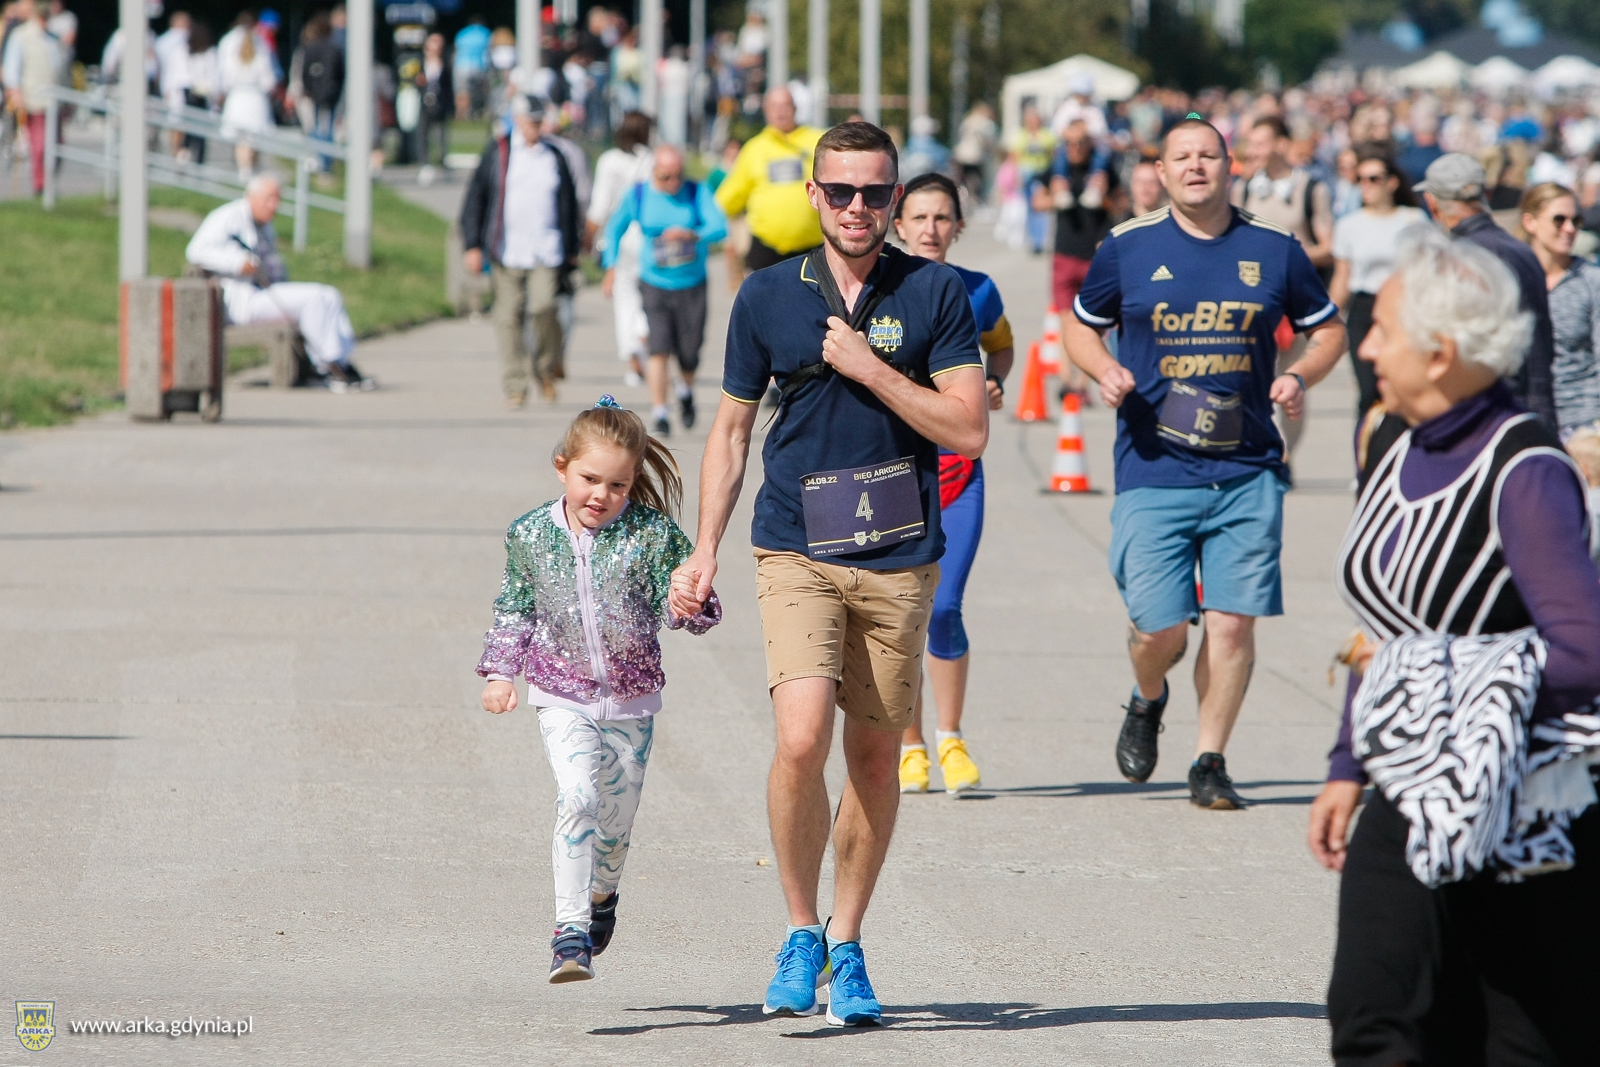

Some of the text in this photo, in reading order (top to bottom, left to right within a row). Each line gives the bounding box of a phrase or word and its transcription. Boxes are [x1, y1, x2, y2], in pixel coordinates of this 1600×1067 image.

[1151, 301, 1264, 332] forBET
[1159, 354, 1251, 379] GDYNIA
[1193, 407, 1217, 434] 16
[853, 461, 911, 481] BIEG ARKOWCA
[855, 491, 874, 522] 4
